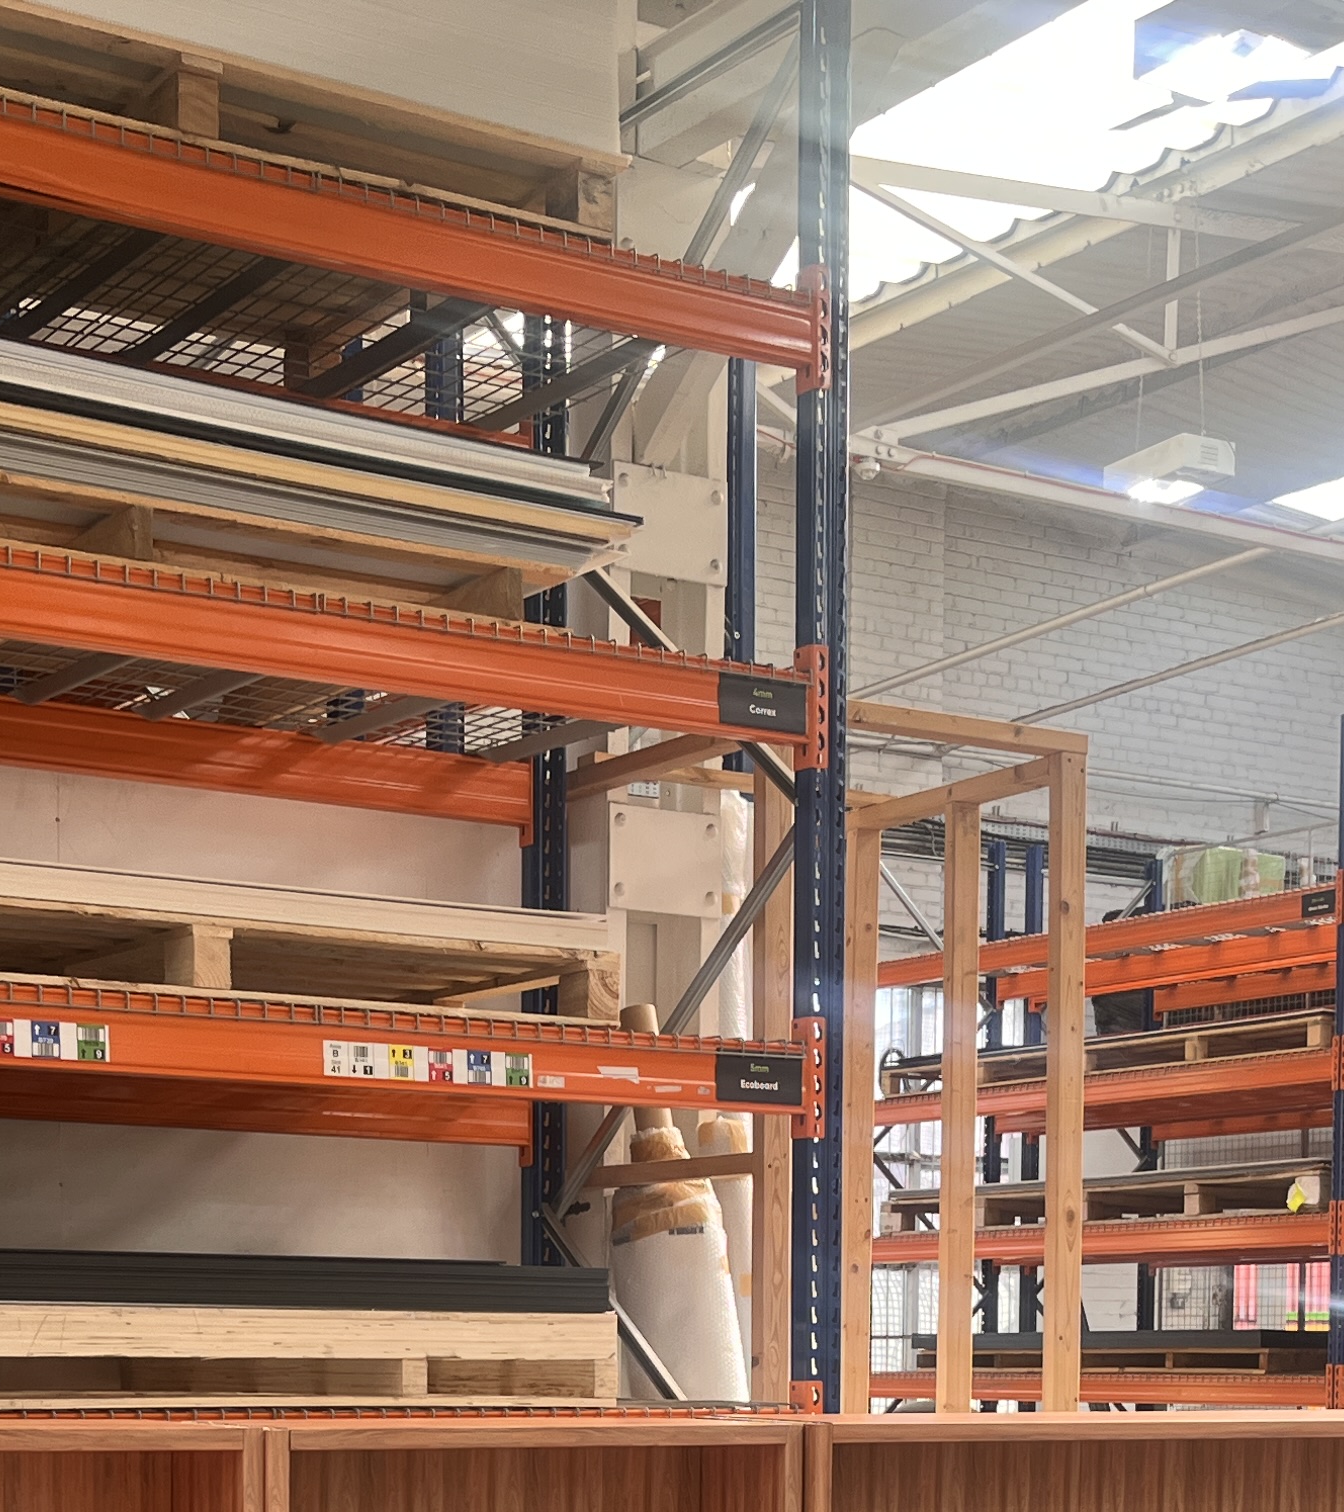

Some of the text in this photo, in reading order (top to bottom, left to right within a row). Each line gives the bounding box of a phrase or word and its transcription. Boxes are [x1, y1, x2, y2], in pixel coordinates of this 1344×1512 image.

[753, 688, 773, 699] 4mm
[49, 1026, 56, 1035] 7
[3, 1043, 11, 1053] 5
[95, 1049, 103, 1059] 9
[332, 1049, 339, 1058] B
[331, 1065, 341, 1074] 41
[740, 1079, 779, 1091] Ecoboard
